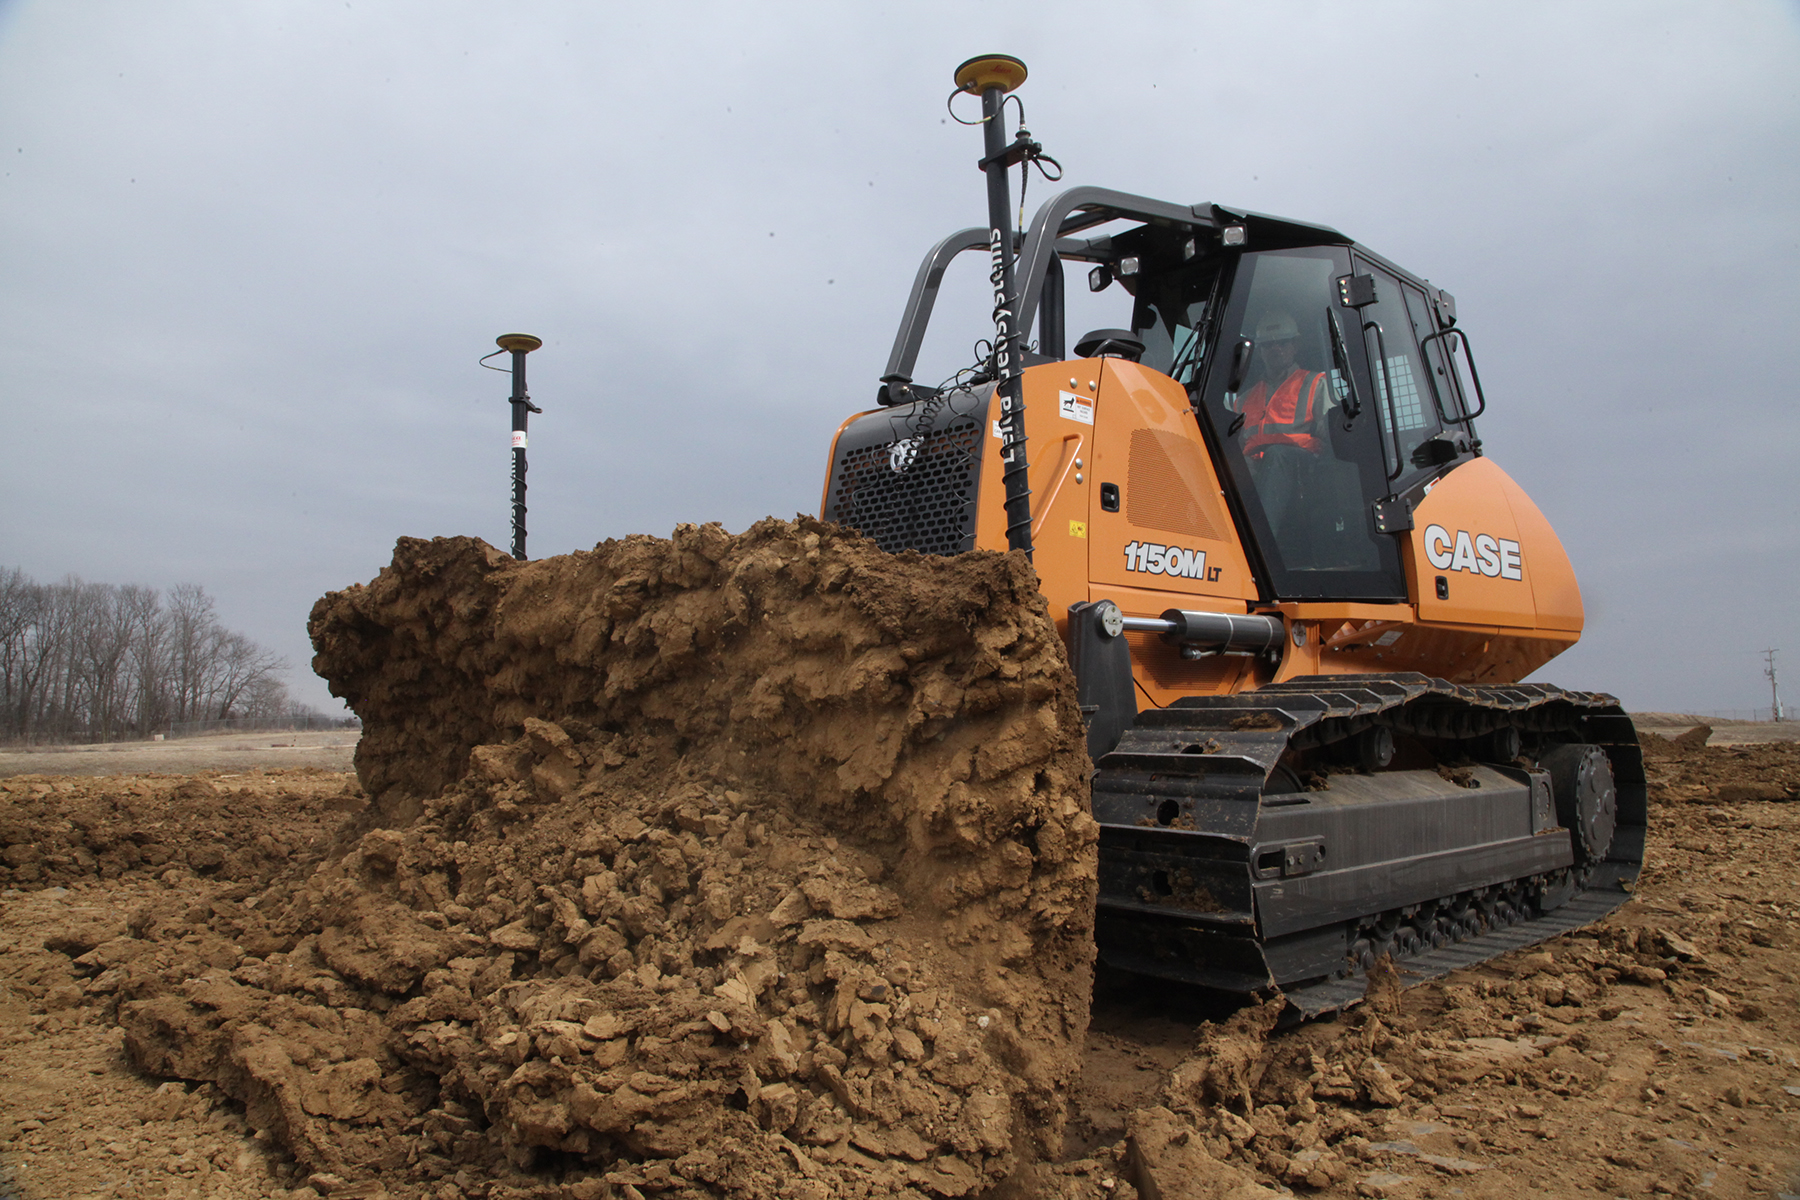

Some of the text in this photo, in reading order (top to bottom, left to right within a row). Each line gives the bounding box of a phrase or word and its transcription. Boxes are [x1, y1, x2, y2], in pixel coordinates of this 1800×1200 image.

[1124, 540, 1222, 582] 1150M LT
[1424, 523, 1522, 581] CASE
